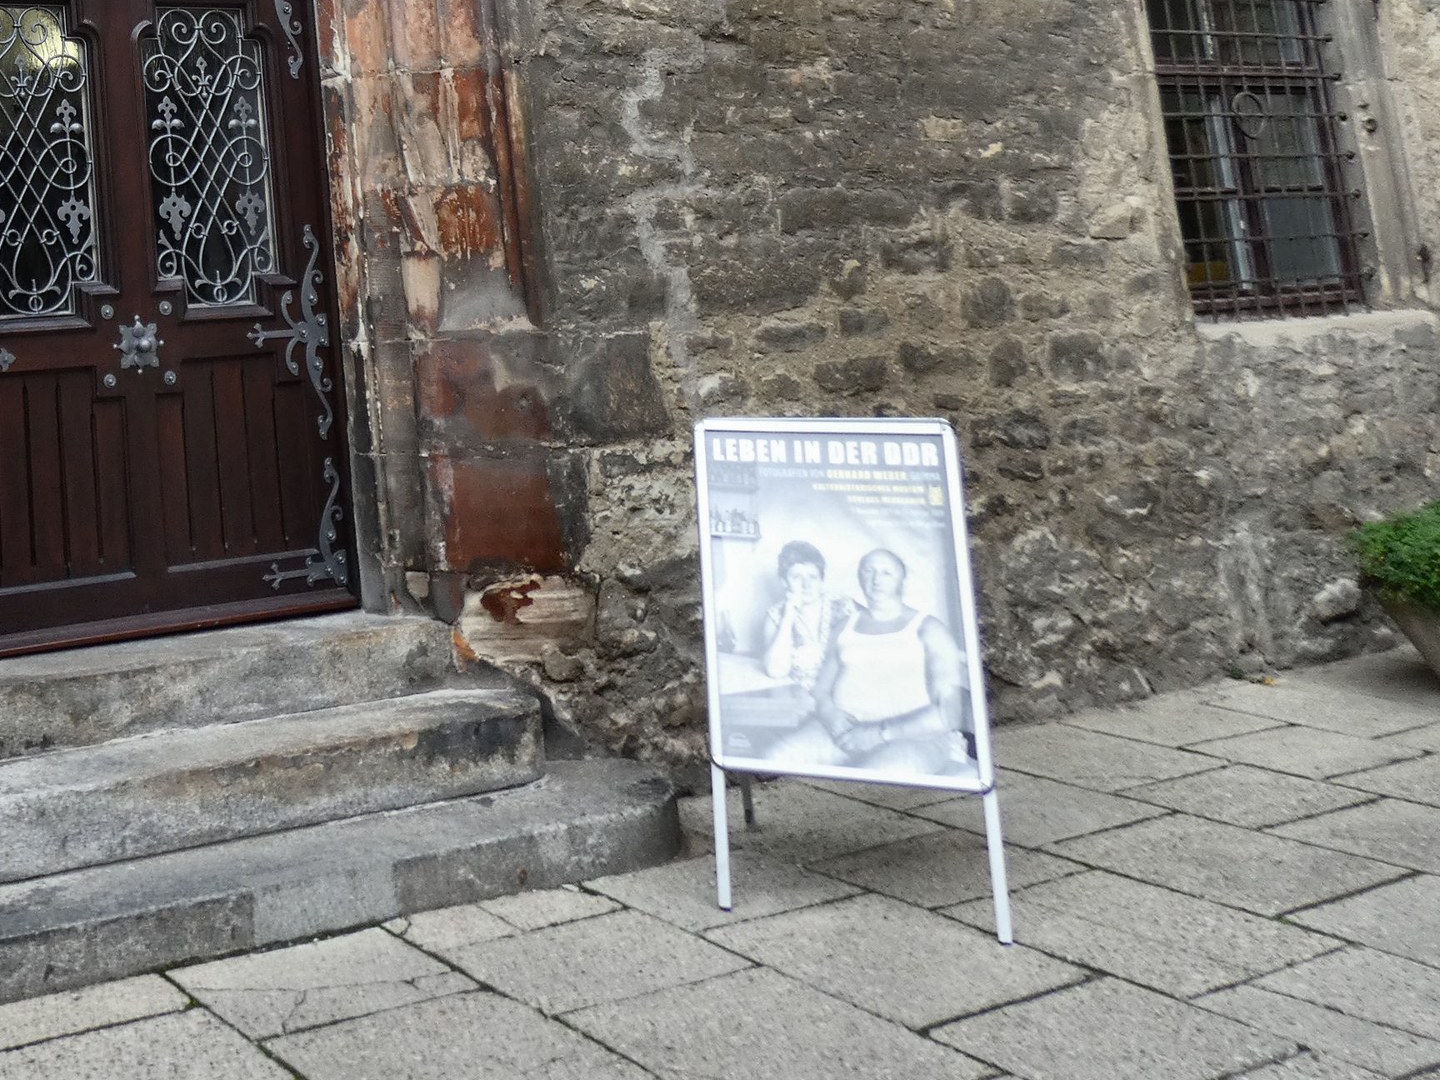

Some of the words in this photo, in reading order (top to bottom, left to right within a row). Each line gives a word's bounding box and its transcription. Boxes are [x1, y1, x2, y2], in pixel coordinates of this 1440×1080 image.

[712, 437, 788, 463] LEBEN
[793, 438, 821, 464] IN
[828, 439, 878, 466] DER
[883, 440, 940, 467] DDR
